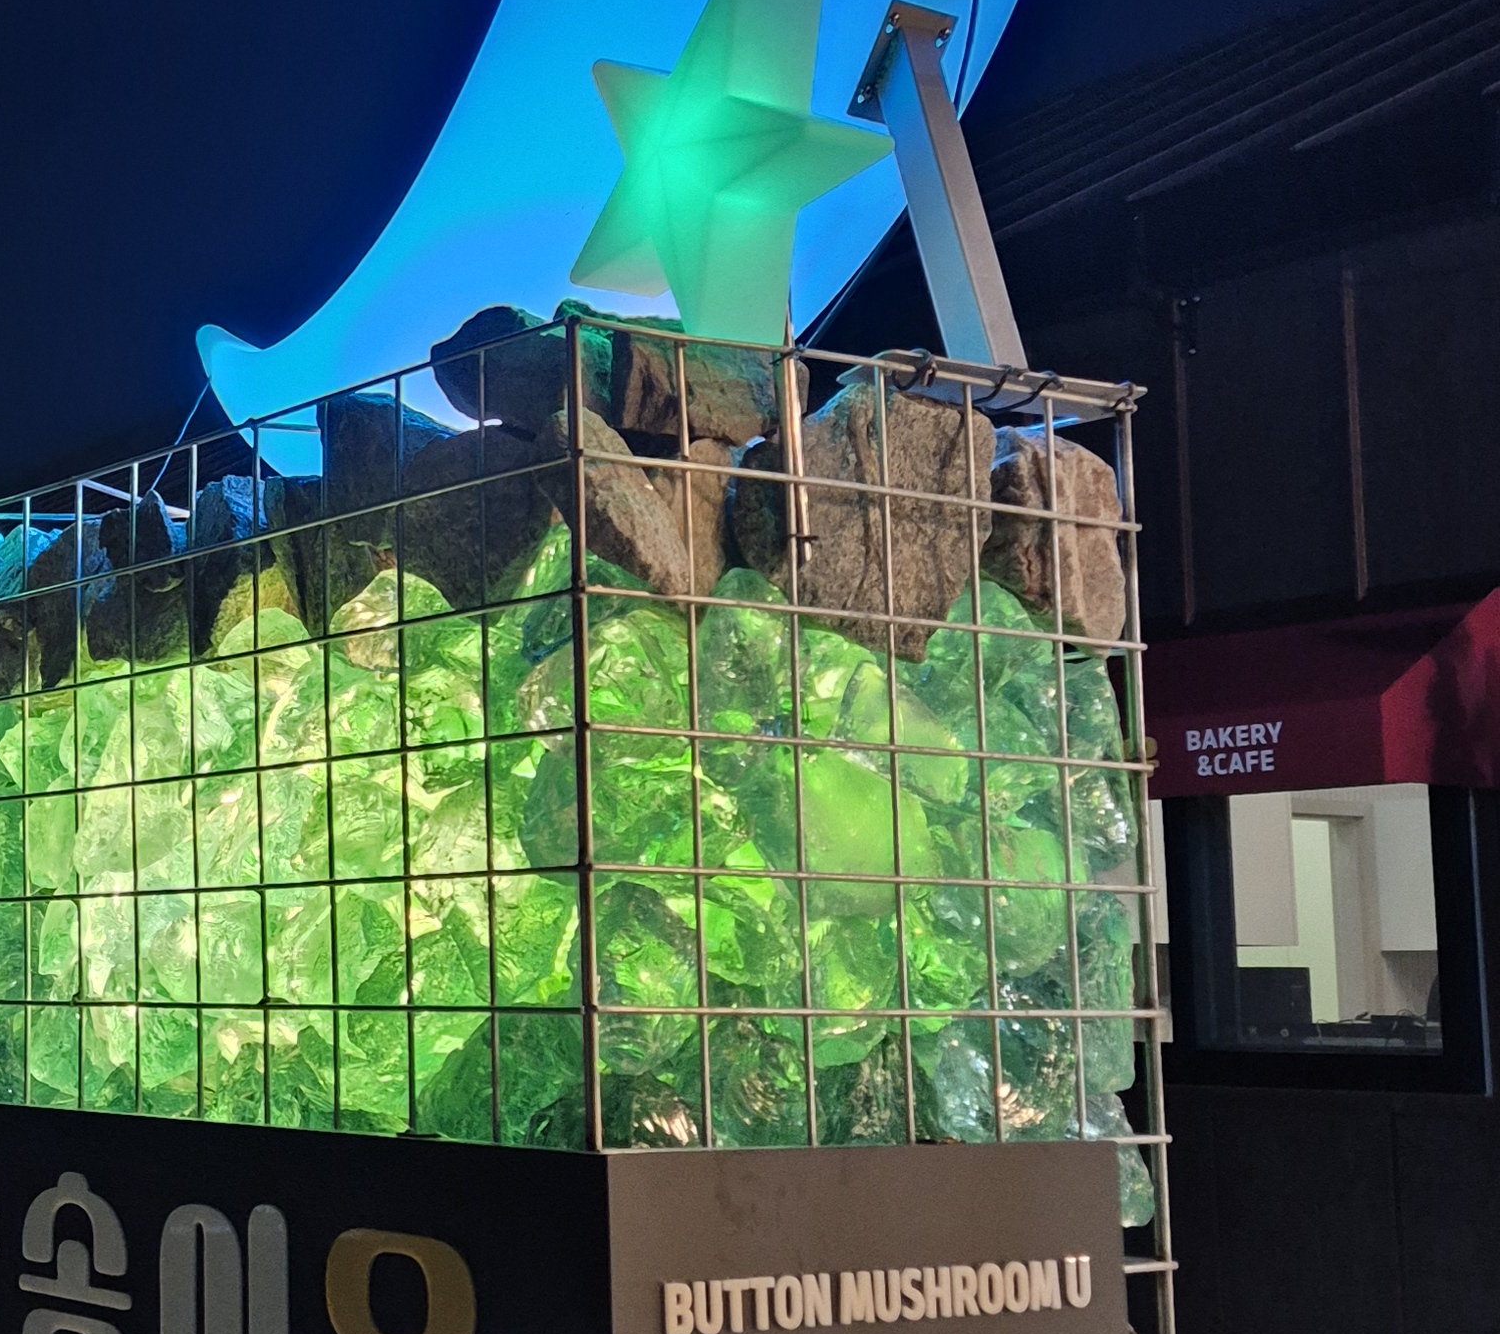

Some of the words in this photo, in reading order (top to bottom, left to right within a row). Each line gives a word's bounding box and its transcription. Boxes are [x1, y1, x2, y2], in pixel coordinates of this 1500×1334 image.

[1186, 721, 1282, 751] BAKERY
[1197, 749, 1275, 776] &CAFE
[840, 1259, 1062, 1325] MUSHROOM
[1065, 1255, 1092, 1309] U
